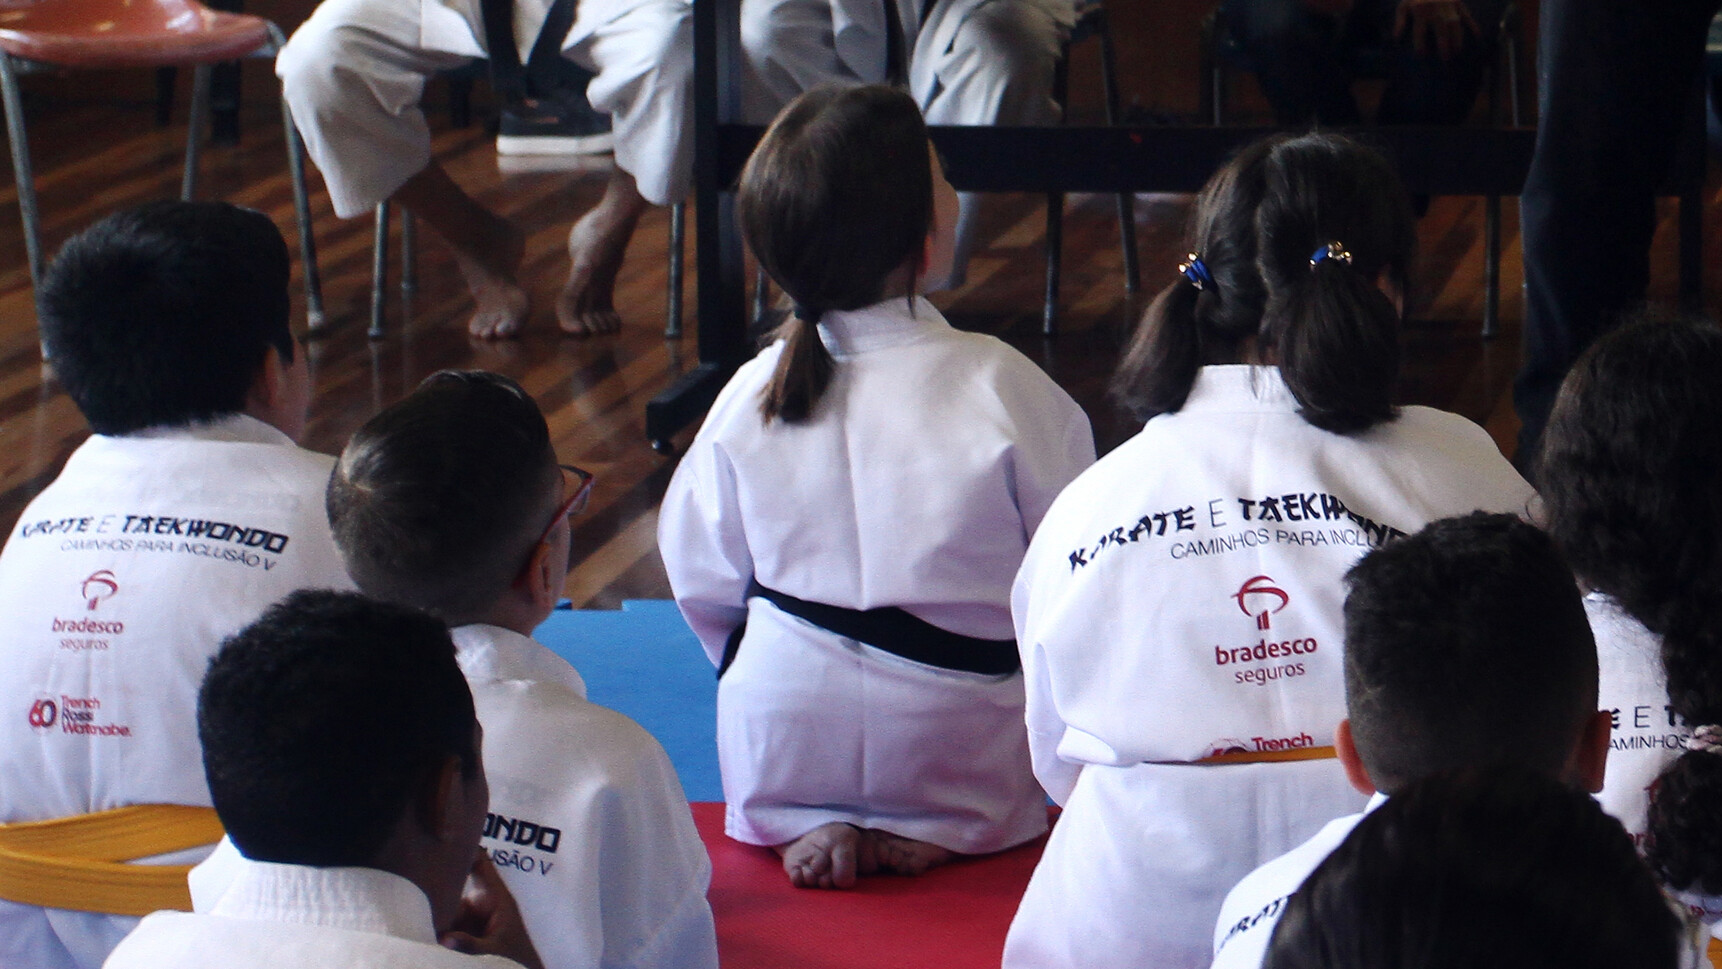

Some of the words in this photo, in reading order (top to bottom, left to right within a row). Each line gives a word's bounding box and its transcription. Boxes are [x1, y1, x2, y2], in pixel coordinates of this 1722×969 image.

[122, 515, 289, 554] TAEKWONDO
[1068, 505, 1196, 575] KARATE
[1208, 498, 1227, 528] E
[1171, 528, 1270, 560] CAMINHOS
[1276, 529, 1328, 546] PARA
[263, 558, 277, 571] V
[52, 617, 124, 634] bradesco
[59, 638, 109, 653] seguros
[1215, 637, 1318, 665] bradesco
[1235, 662, 1306, 686] seguros
[1634, 706, 1651, 728] E
[1251, 732, 1314, 752] Trench
[540, 860, 554, 876] V
